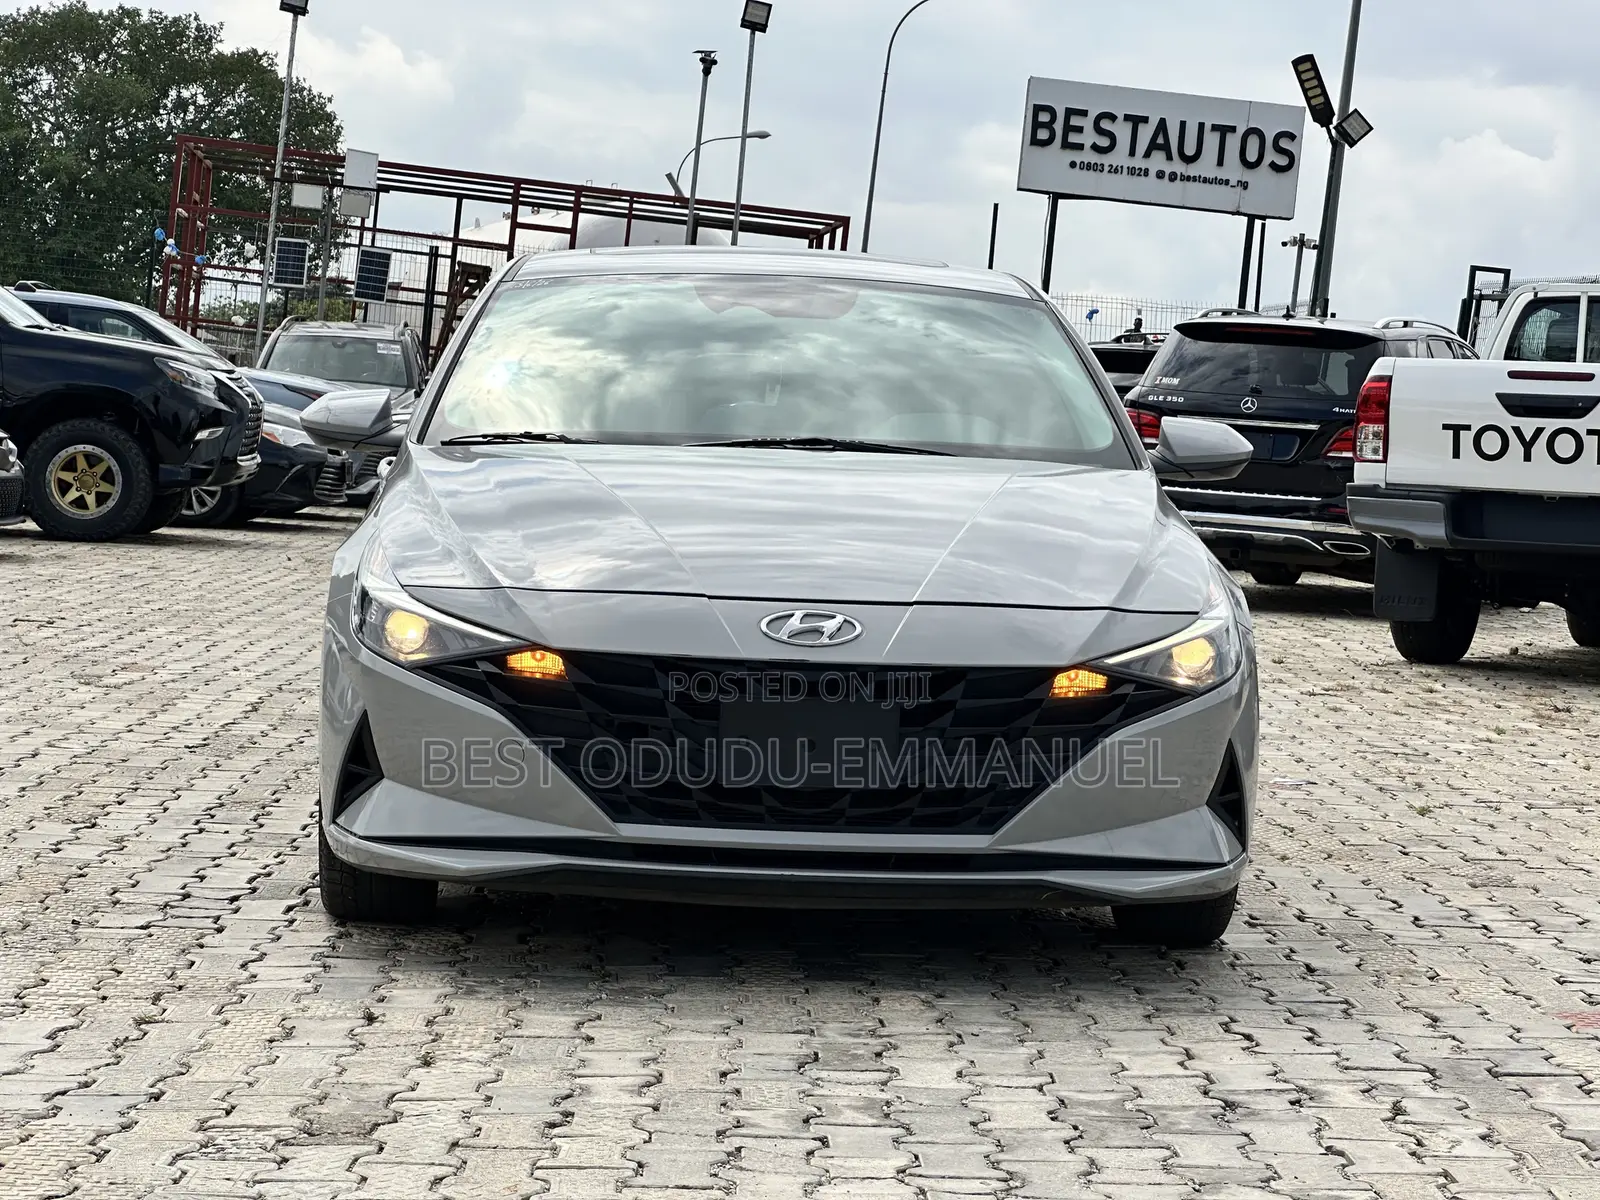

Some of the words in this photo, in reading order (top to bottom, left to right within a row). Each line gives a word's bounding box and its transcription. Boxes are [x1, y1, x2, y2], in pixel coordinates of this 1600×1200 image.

[1029, 103, 1298, 173] BESTAUTOS
[1079, 161, 1105, 173] 0803
[1107, 164, 1124, 175] 261
[1126, 166, 1150, 177] 1028
[1168, 171, 1249, 191] @bestautos_ng
